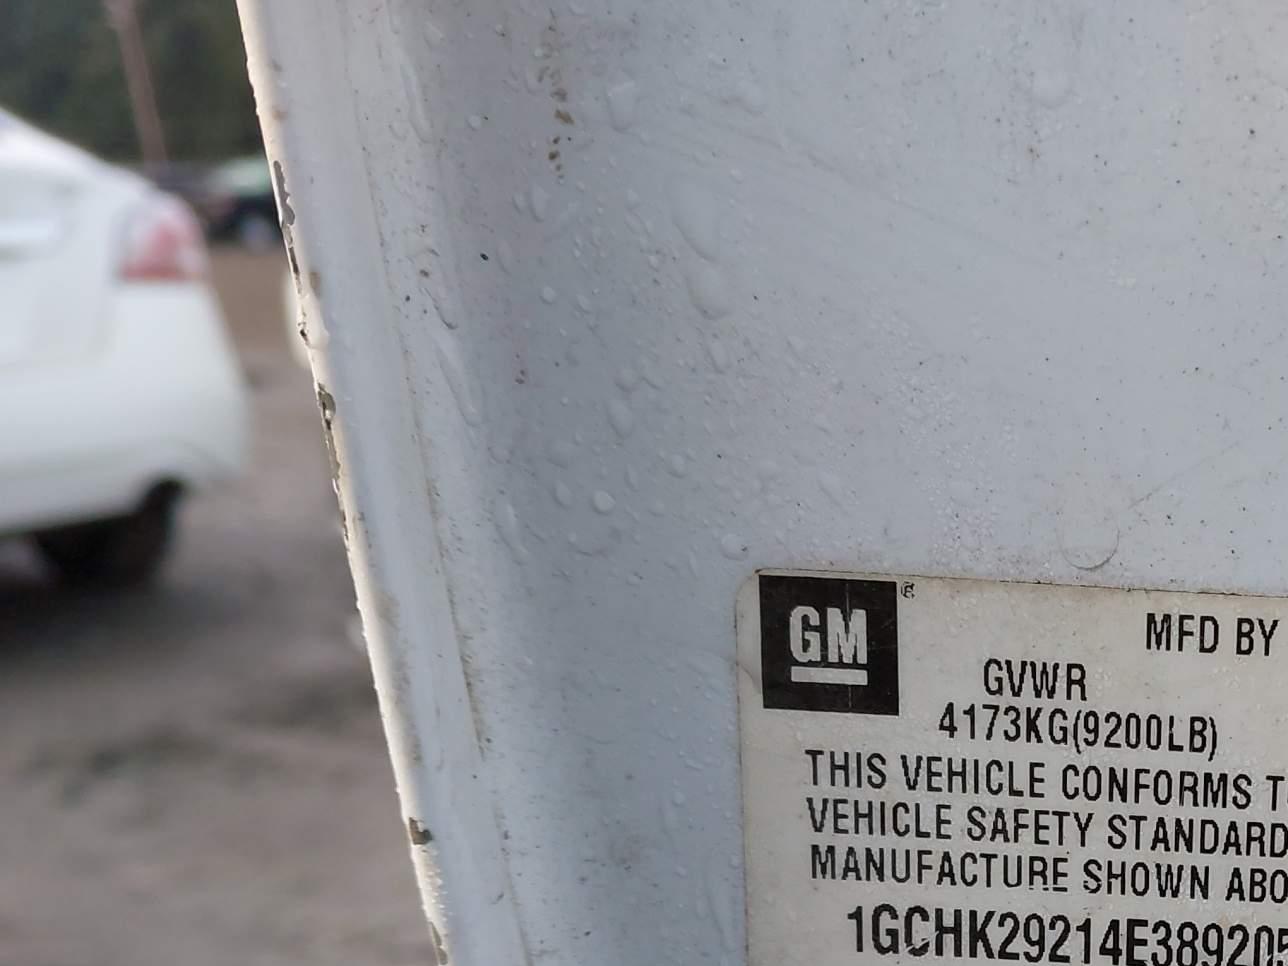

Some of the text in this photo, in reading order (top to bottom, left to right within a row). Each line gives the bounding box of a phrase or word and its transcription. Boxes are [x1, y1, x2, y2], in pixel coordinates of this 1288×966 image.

[790, 606, 867, 664] GM
[1145, 612, 1220, 654] MFD
[1235, 617, 1281, 657] BY
[983, 657, 1088, 702] GVWR
[938, 701, 1218, 763] 4173KG(9200LB)
[804, 749, 887, 790] THIS
[899, 754, 1046, 799] VEHICLE
[1061, 763, 1253, 810] CONFORMS
[805, 796, 952, 840] VEHICLE
[966, 805, 1095, 848] SAFETY
[810, 843, 1069, 893] MANUFACTURE
[1082, 858, 1210, 900] SHOWN
